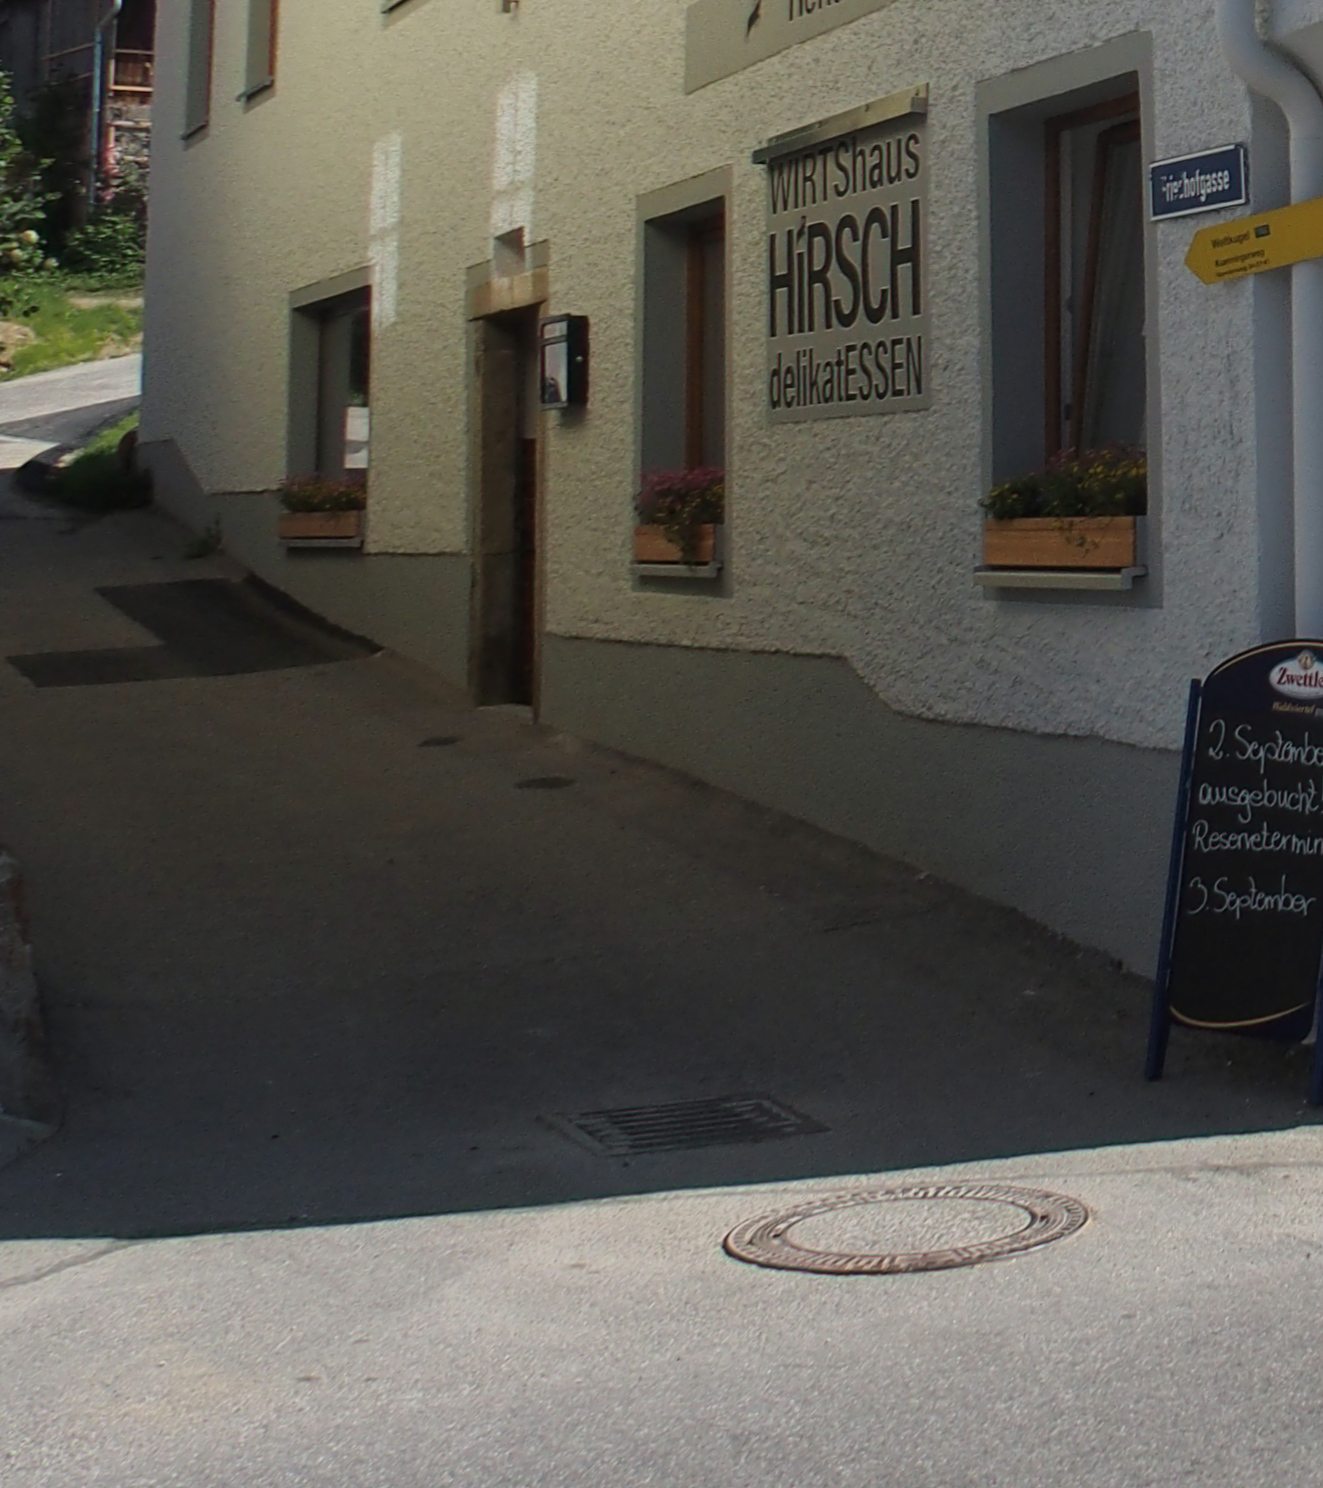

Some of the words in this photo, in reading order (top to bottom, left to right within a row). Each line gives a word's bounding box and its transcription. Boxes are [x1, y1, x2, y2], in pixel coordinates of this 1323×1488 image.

[769, 132, 921, 215] WIRTShaus
[769, 334, 923, 411] delikatESSEN
[1213, 874, 1317, 919] September
